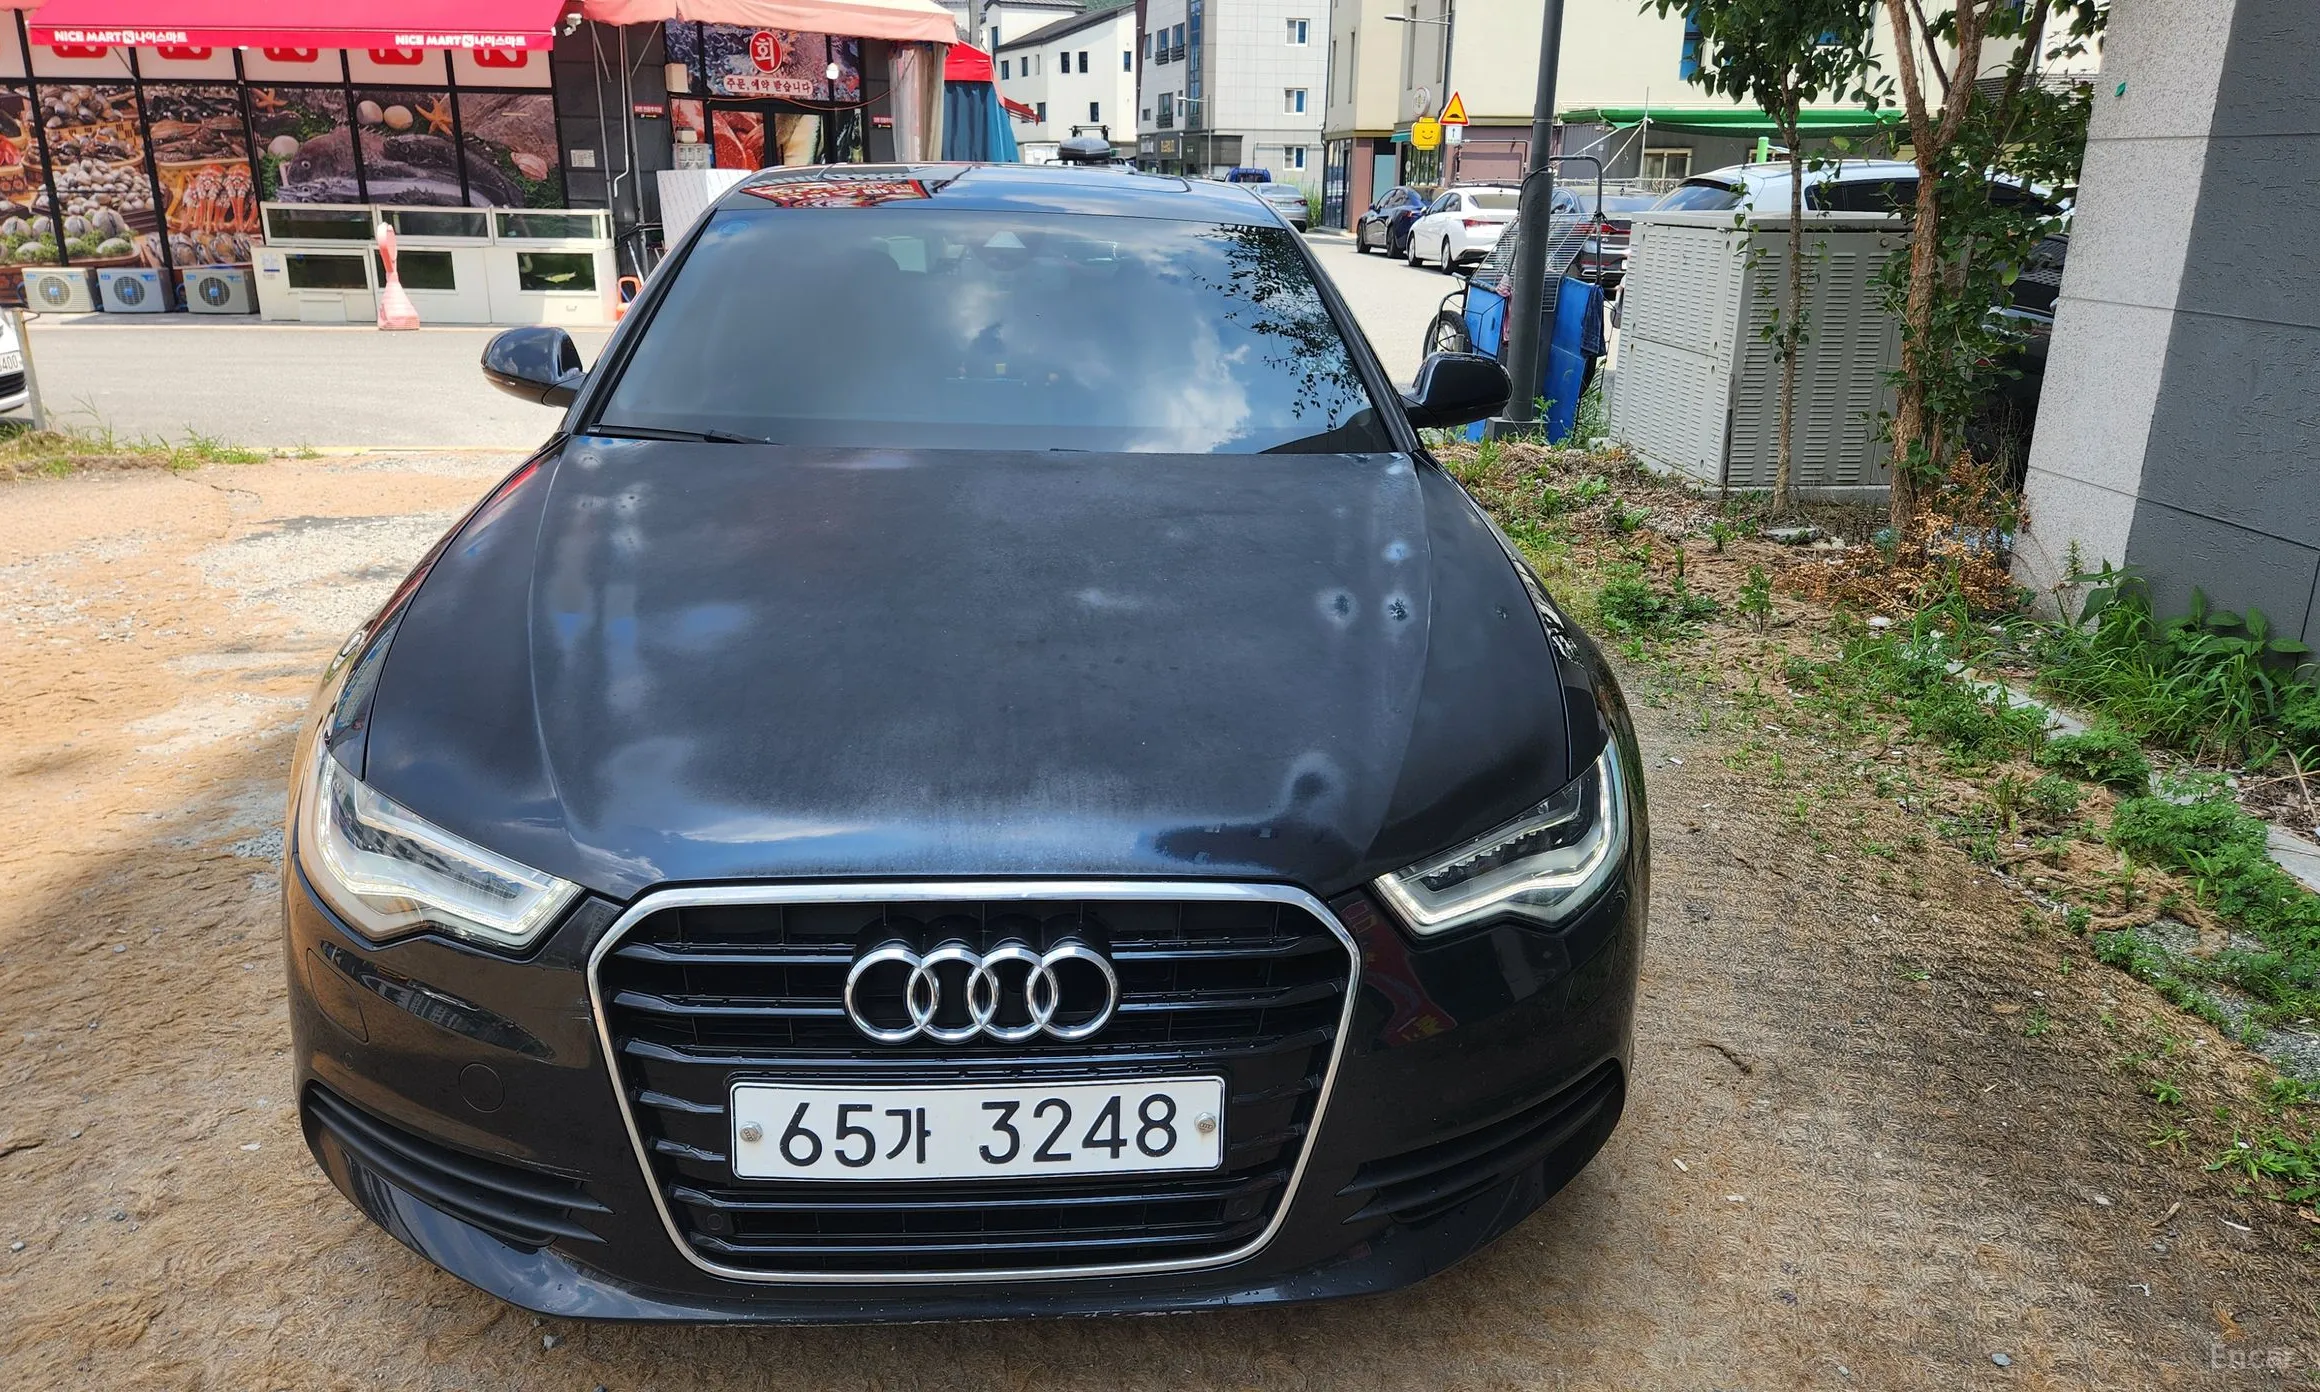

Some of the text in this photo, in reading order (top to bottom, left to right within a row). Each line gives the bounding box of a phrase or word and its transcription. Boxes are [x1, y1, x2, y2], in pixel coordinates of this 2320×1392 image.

[54, 31, 84, 42] NICE
[86, 31, 122, 42] MART
[135, 31, 188, 44] 나이스마트
[395, 35, 424, 46] NICE
[426, 35, 461, 46] MART
[475, 35, 526, 48] 나이스마트
[754, 36, 776, 69] 회
[773, 80, 811, 93] 받습니다
[779, 1093, 1178, 1167] 65가 3248
